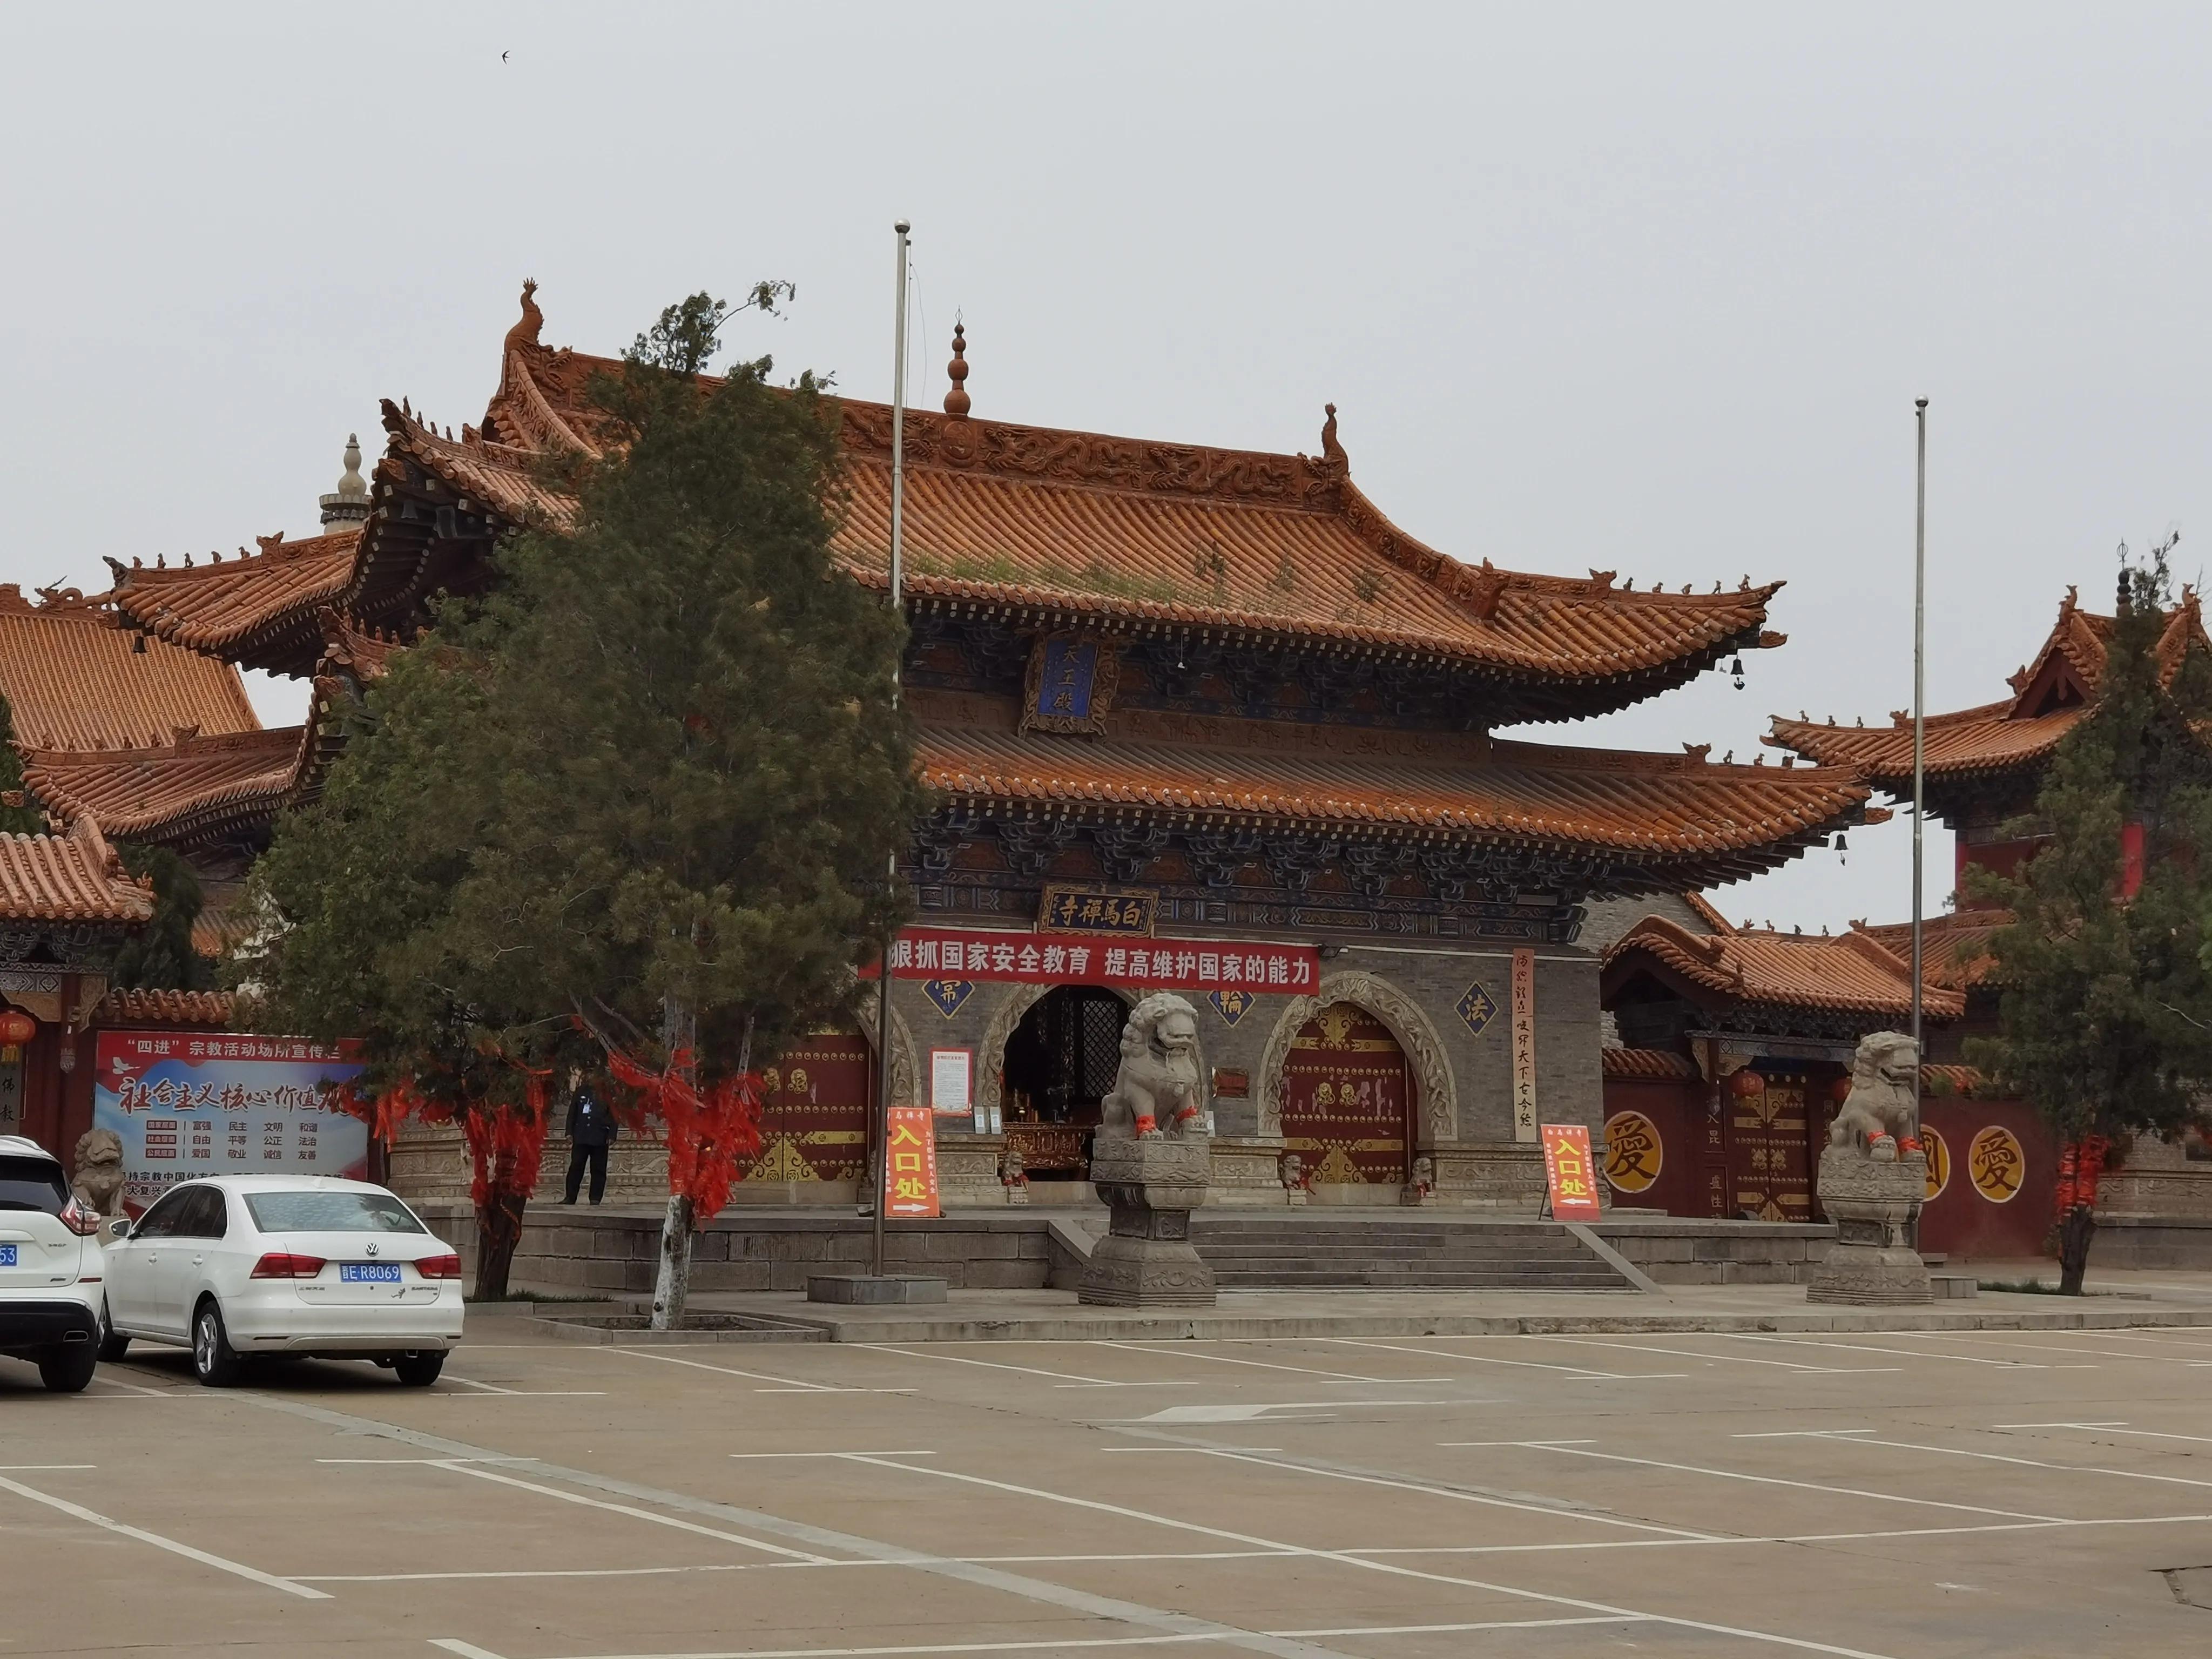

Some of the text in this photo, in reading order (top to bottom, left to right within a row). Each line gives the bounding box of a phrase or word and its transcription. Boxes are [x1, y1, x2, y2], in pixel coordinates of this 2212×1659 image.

[1054, 645, 1080, 711] 天王殿
[892, 939, 1310, 984] 狠抓国家安全教育 提高维护国家的能力
[1465, 994, 1488, 1022] 法
[193, 1121, 212, 1130] 富强
[229, 1122, 247, 1131] 民主
[264, 1122, 282, 1132] 文明
[299, 1123, 318, 1132] 和谐
[193, 1136, 211, 1144] 自由
[228, 1136, 246, 1145] 平等
[264, 1136, 282, 1145] 公正
[299, 1137, 316, 1146] 法治
[192, 1149, 210, 1158] 爱国
[228, 1150, 246, 1158] 敬业
[264, 1150, 281, 1159] 诚信
[298, 1151, 316, 1159] 友善
[892, 1124, 927, 1199] 入口处
[1554, 1139, 1588, 1196] 入口处
[1974, 1130, 2017, 1191] 愛
